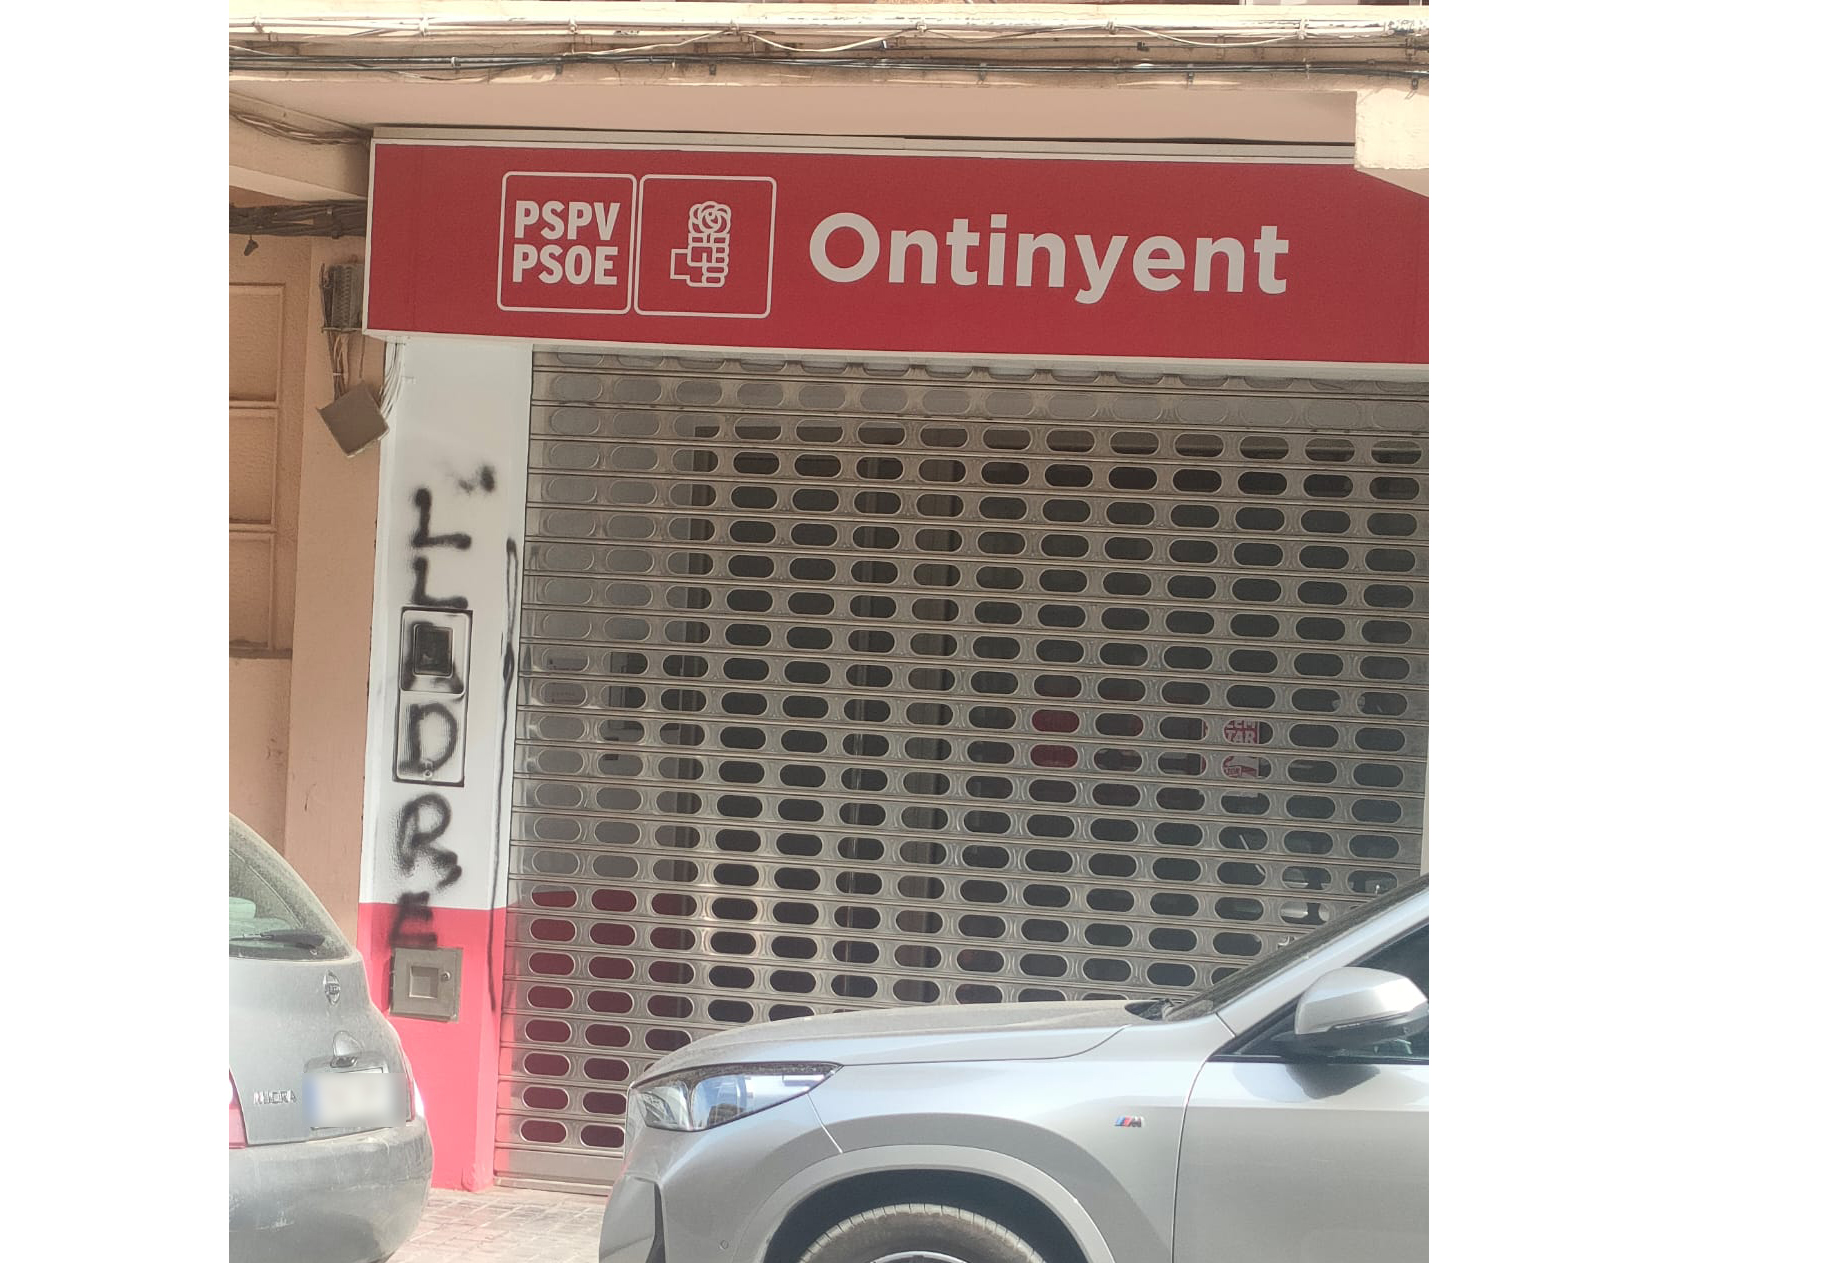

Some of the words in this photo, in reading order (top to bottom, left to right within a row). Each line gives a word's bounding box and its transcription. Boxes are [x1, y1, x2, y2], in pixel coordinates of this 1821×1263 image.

[514, 200, 621, 241] PSPV
[512, 243, 619, 286] PSOE
[809, 212, 1290, 305] Ontinyent
